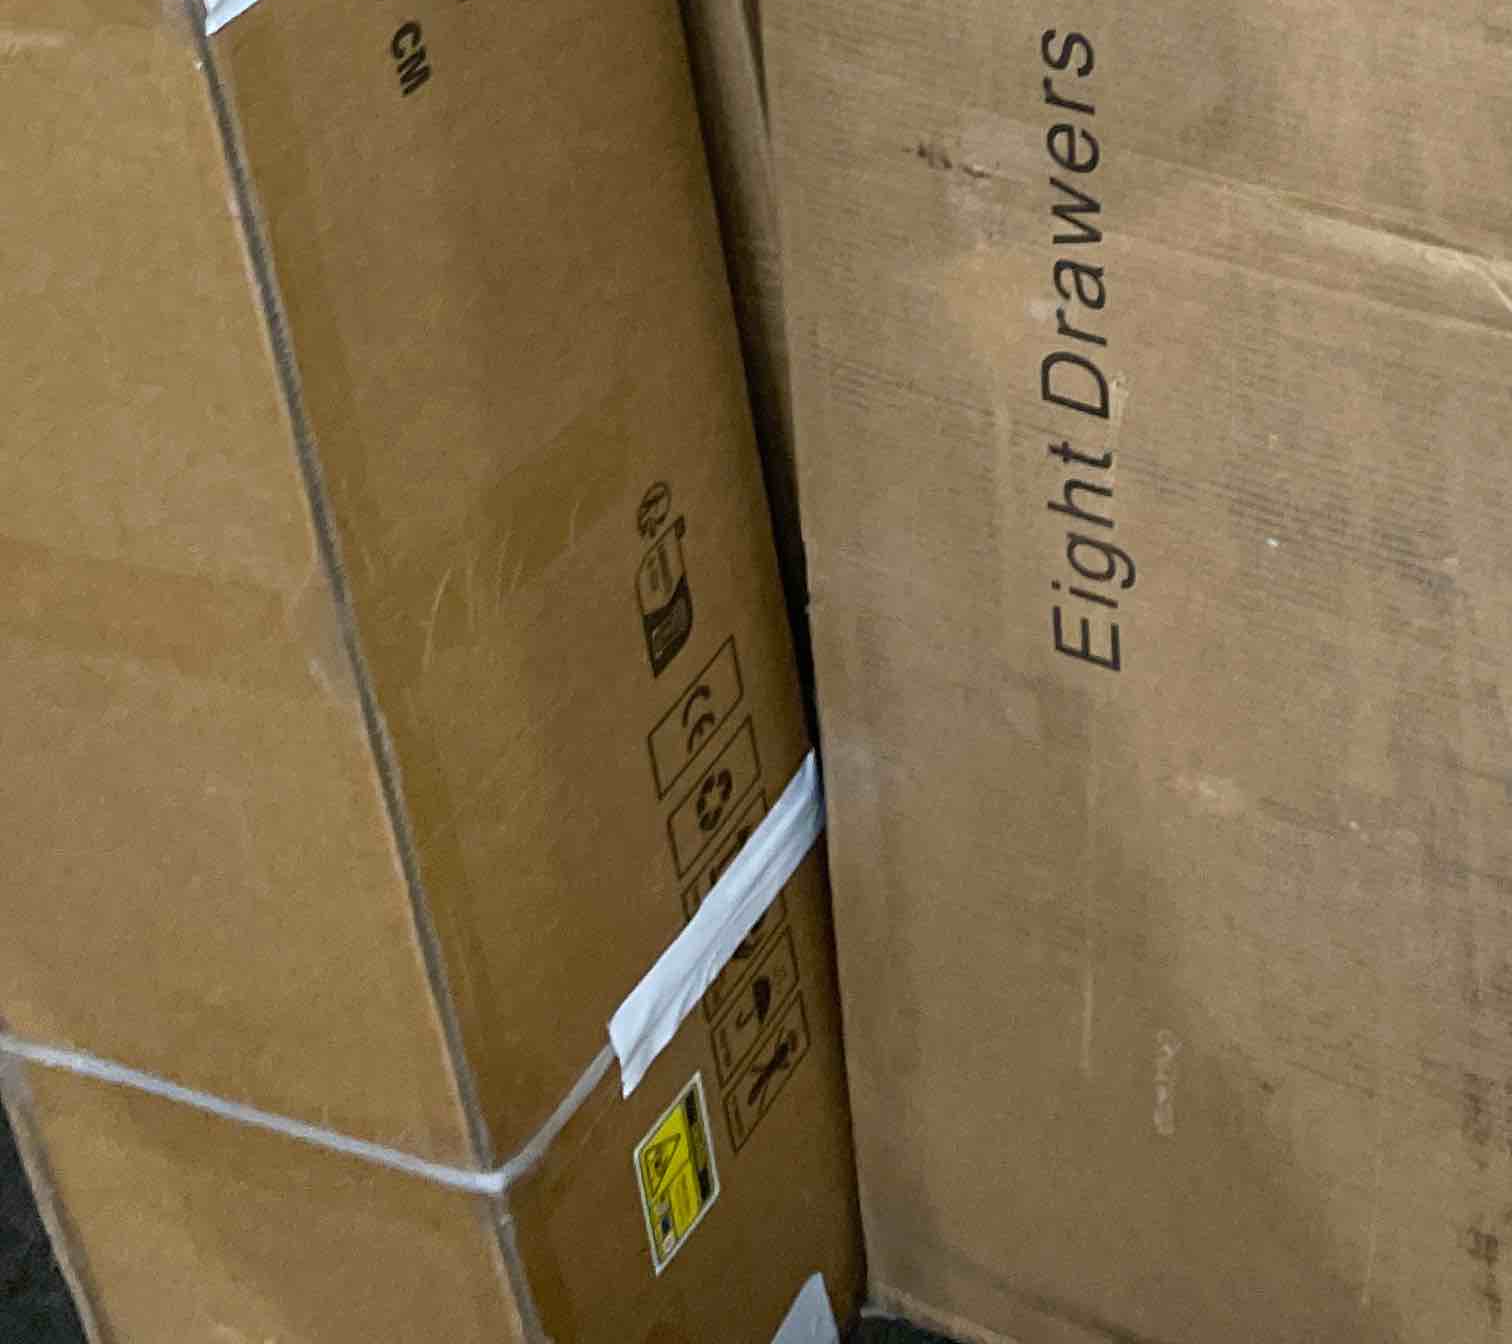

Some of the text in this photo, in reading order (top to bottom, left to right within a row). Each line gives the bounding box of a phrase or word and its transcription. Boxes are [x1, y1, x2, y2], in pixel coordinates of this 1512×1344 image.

[391, 20, 430, 98] CM
[1040, 25, 1109, 420] Drawers
[1050, 440, 1134, 670] Eight
